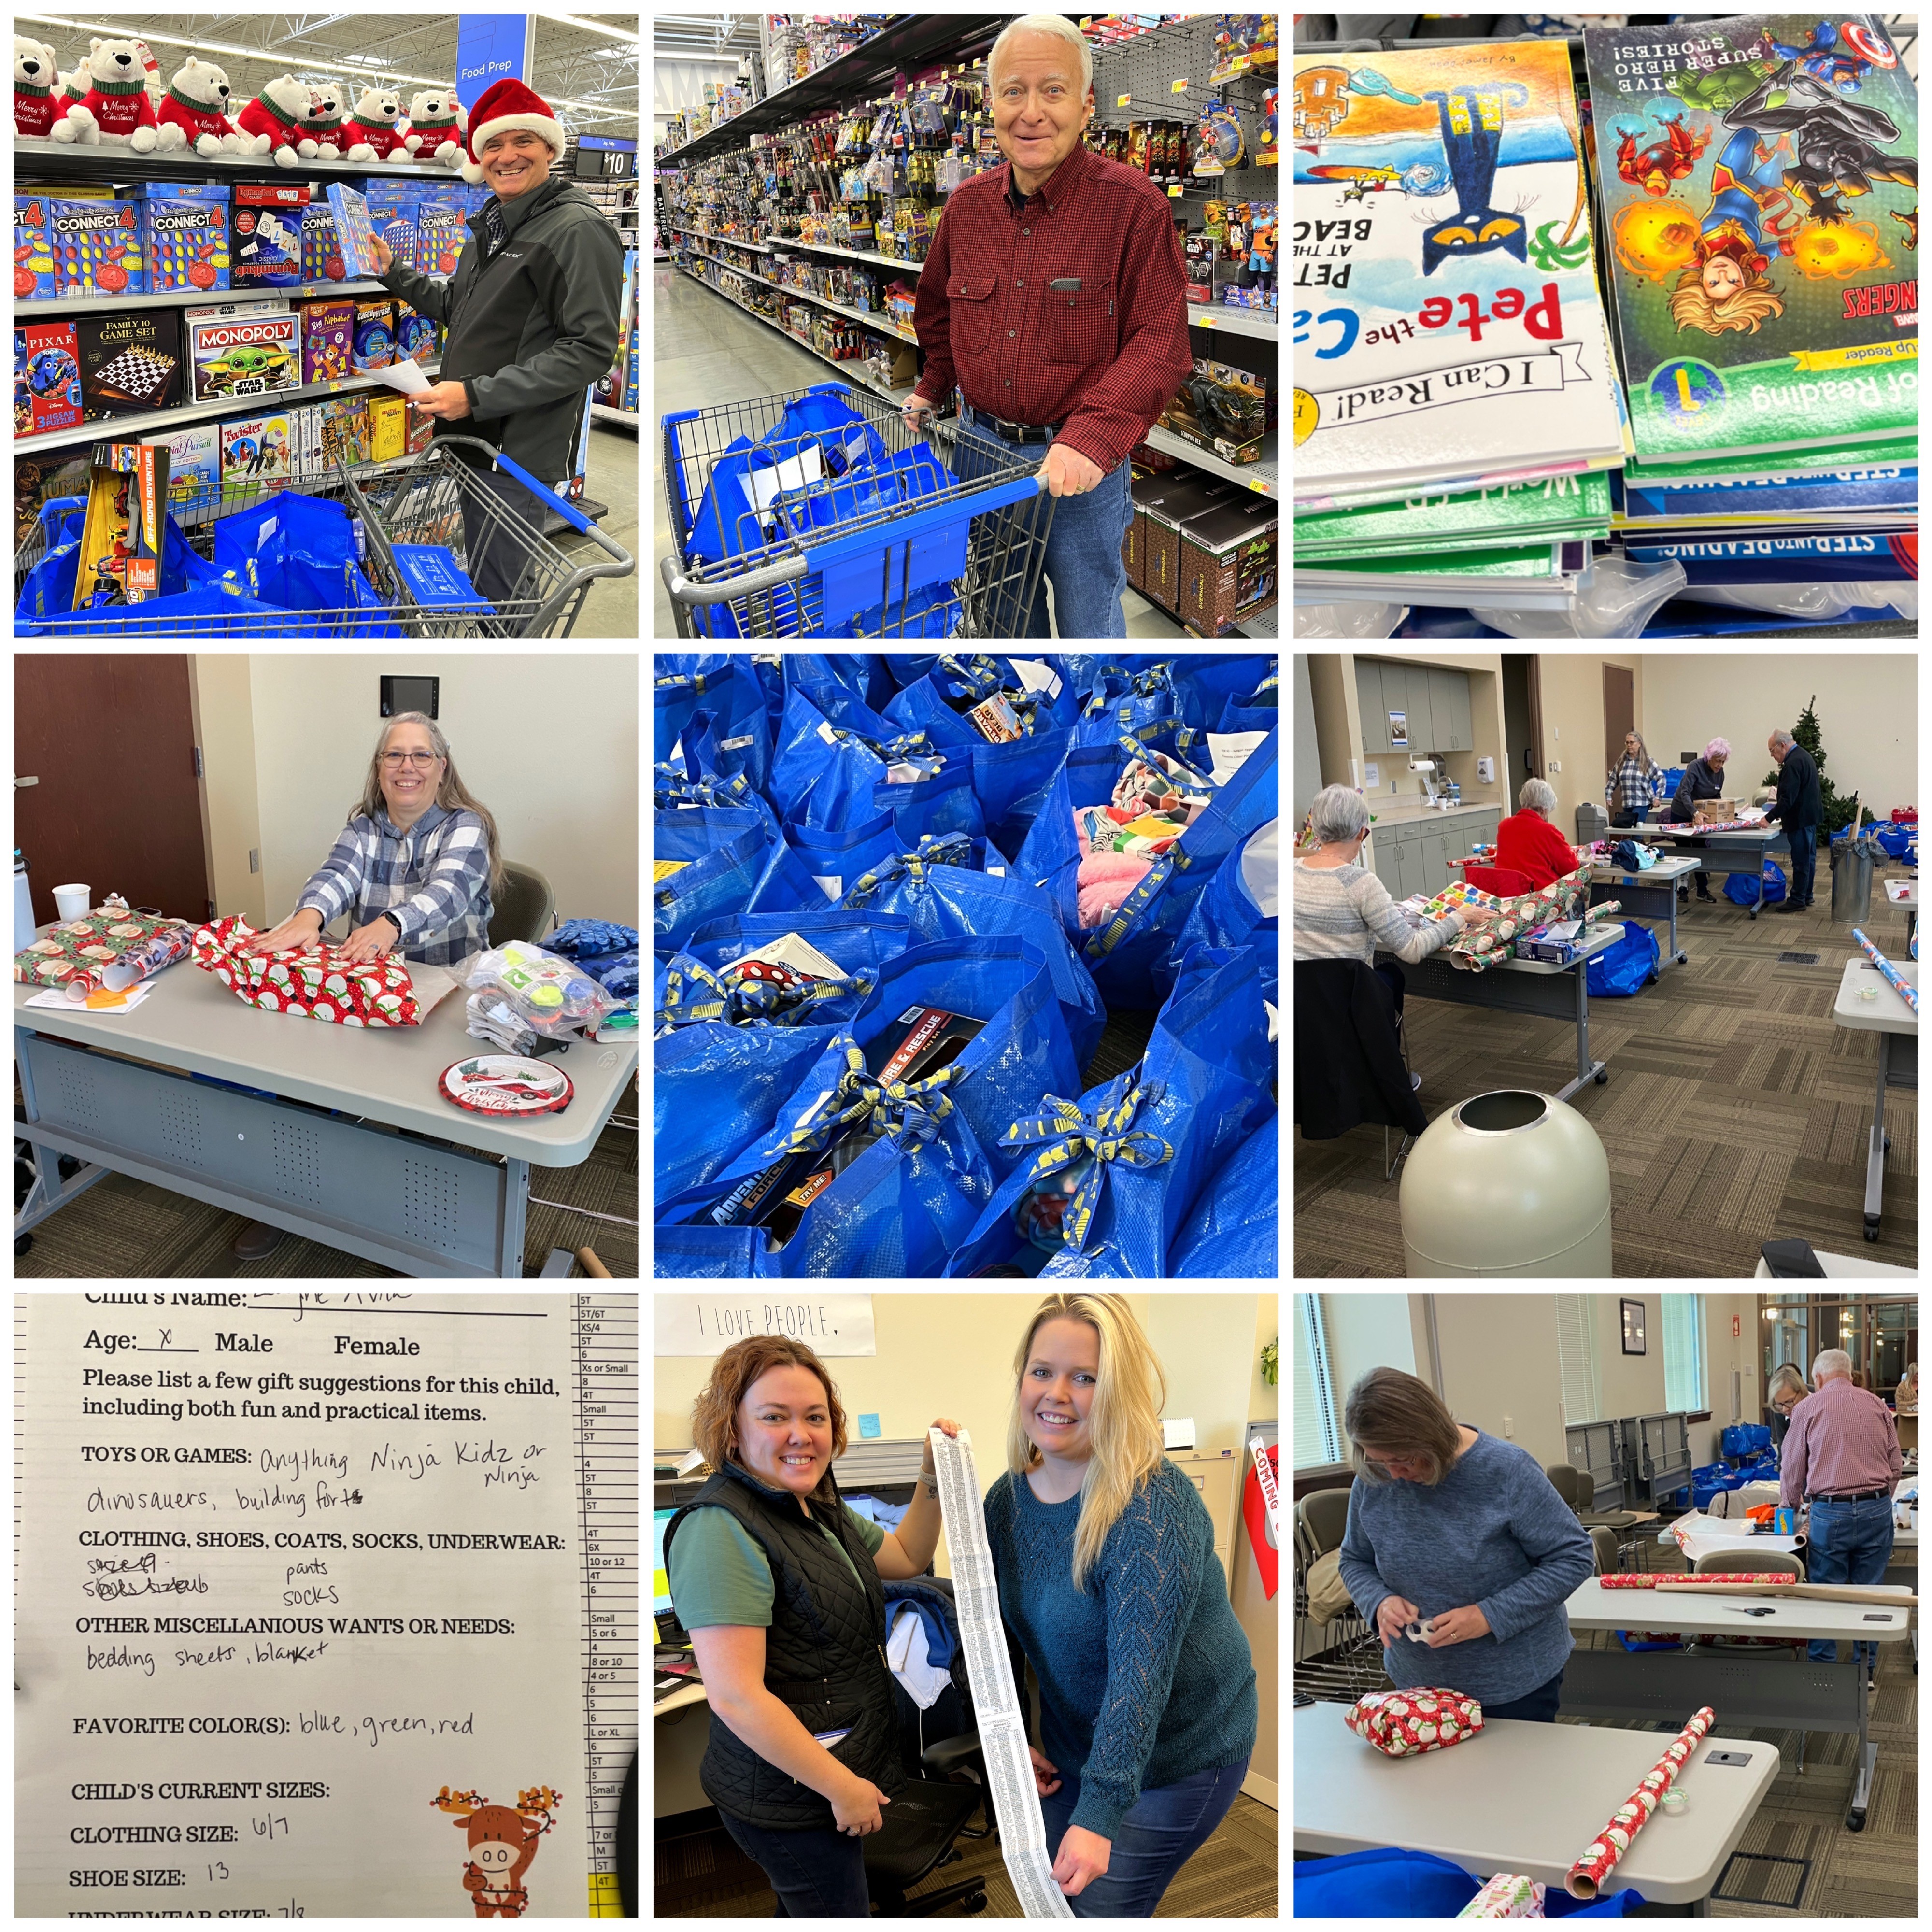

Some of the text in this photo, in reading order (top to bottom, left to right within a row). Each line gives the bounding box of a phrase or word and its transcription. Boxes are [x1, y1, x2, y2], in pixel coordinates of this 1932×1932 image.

[1614, 37, 1725, 60] STORIES!
[461, 60, 512, 79] Food Prep
[1614, 47, 1762, 76] SUPER HERO
[1619, 76, 1679, 93] FIVE
[103, 111, 134, 121] Christmas
[110, 100, 129, 113] Merry
[604, 153, 624, 174] $10
[57, 215, 120, 231] CONNECT
[657, 197, 668, 236] BATTERIES
[1293, 219, 1373, 242] BEAC
[1327, 244, 1352, 256] AT
[1293, 263, 1352, 288] PET
[106, 321, 138, 330] FAMILY
[311, 320, 322, 330] Big
[324, 314, 351, 326] Alphabet
[1293, 282, 1563, 359] Pete the Ca
[29, 335, 74, 349] PIXAR
[99, 330, 132, 341] GAME
[136, 327, 157, 336] SET
[202, 324, 291, 347] MONOPOLY
[1846, 346, 1893, 360] Reader
[1444, 364, 1511, 389] Can
[1520, 361, 1534, 385] I
[235, 386, 263, 395] WARS
[1337, 378, 1435, 421] Read!
[1676, 369, 1700, 412] 1
[1751, 375, 1883, 412] Reading
[37, 410, 75, 428] 3 JIGSAW
[46, 415, 76, 426] PUZZLES
[1675, 413, 1711, 427] LEVEL
[224, 423, 262, 442] Twister
[1236, 599, 1262, 615] OVERWORLD
[975, 709, 1001, 742] BEWARE
[985, 709, 1003, 732] BEAR
[878, 1015, 941, 1085] FIRE & RESCUE
[480, 1089, 511, 1102] Merry
[749, 1160, 788, 1204] FORCE
[799, 1174, 827, 1201] TRY ME!
[581, 1310, 605, 1319] 5T/6T
[697, 1305, 704, 1335] I
[715, 1308, 754, 1336] LOVE
[581, 1323, 600, 1333] XS/4
[83, 1330, 137, 1354] Age:
[215, 1333, 273, 1352] Male
[334, 1336, 420, 1356] Female
[82, 1369, 560, 1397] Please list a few gift suggestions for this child,
[82, 1398, 487, 1422] including both fun and practical items.
[81, 1447, 252, 1463] TOYS OR GAMES:
[260, 1440, 547, 1481] anything Ninja Kidz or
[484, 1465, 540, 1489] Ninja
[1256, 1447, 1278, 1510] COMING
[235, 1485, 306, 1517] building
[79, 1531, 566, 1550] CLOTHING, SHOES, COATS, SOCKS, UNDERWEAR:
[286, 1558, 328, 1584] pants
[590, 1558, 600, 1566] 10
[283, 1585, 339, 1606] socks
[76, 1618, 515, 1634] OTHER MISCELLANIOUS WANTS OR NEEDS:
[87, 1645, 155, 1676] bedding
[73, 1717, 290, 1735] FAVORITE COLOR(S):
[71, 1782, 330, 1800] CHILD'S CURRENT SIZES:
[71, 1826, 239, 1843] CLOTHING SIZE:
[252, 1812, 288, 1840] 6/7
[69, 1869, 186, 1886] SHOE SIZE:
[208, 1862, 229, 1881] 13
